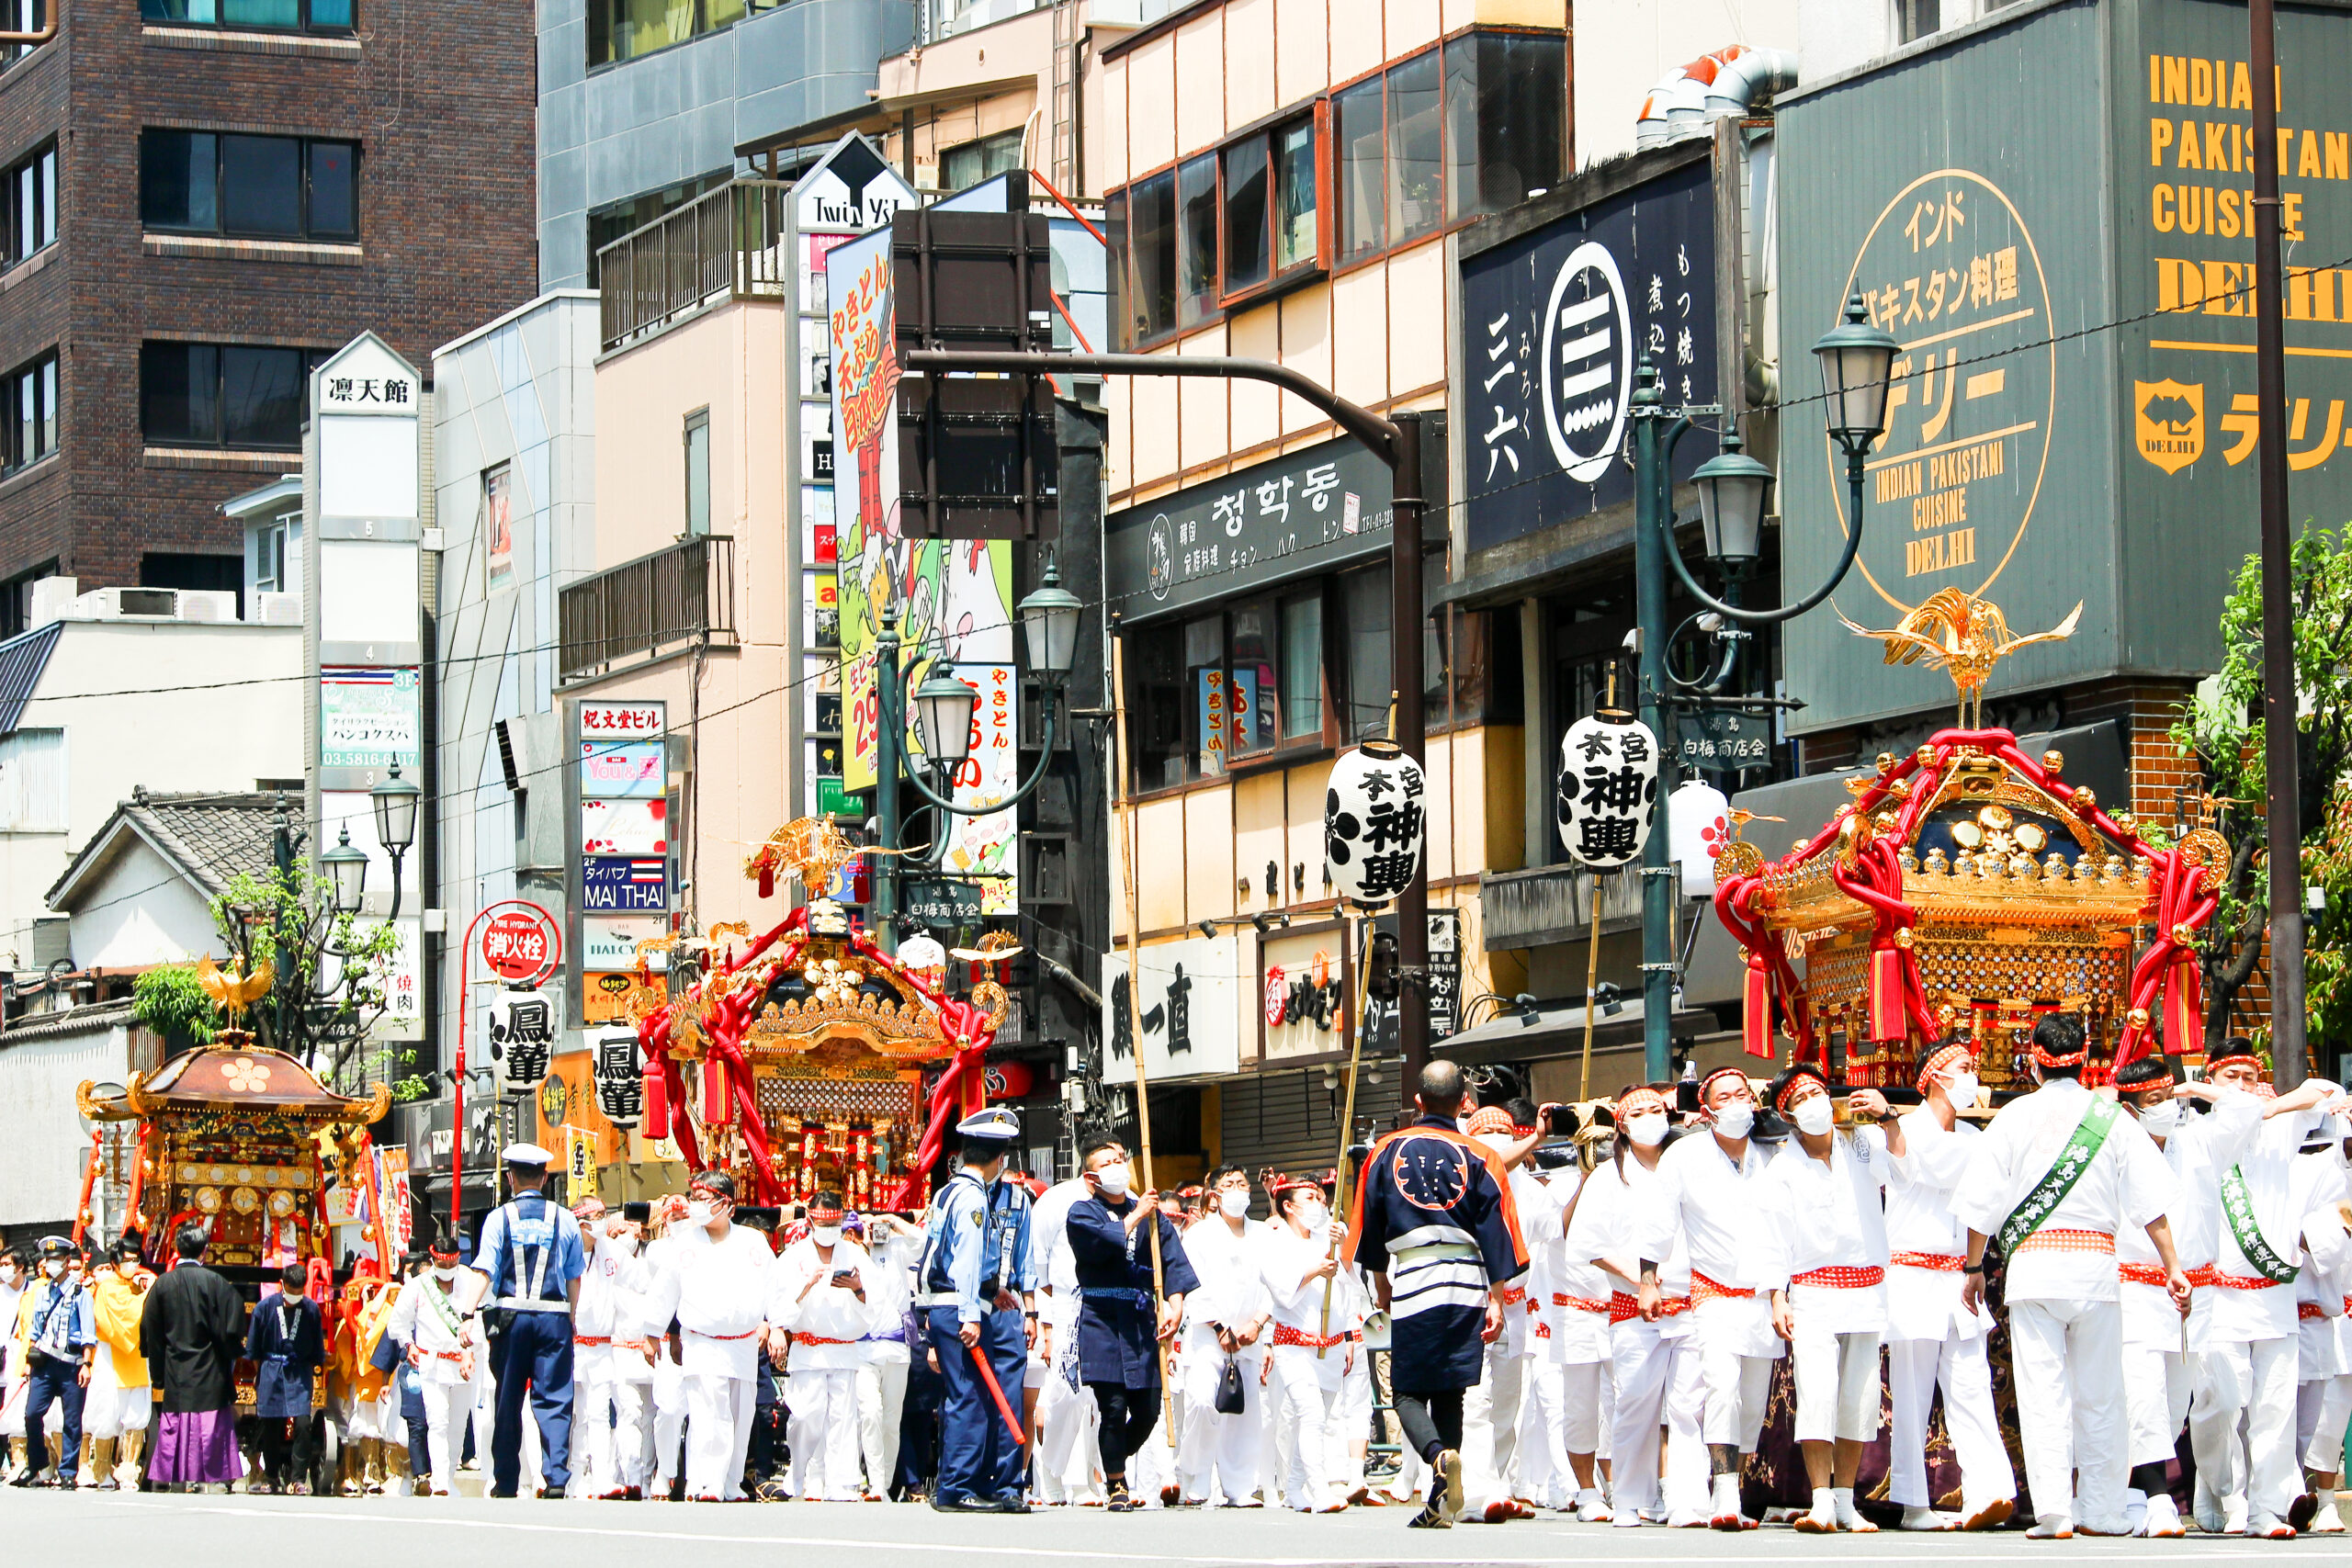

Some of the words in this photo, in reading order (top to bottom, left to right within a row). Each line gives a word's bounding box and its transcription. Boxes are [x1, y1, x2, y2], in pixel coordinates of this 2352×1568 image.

[2150, 54, 2281, 112] INDIA
[813, 197, 862, 223] Twin
[869, 197, 890, 223] Y's
[1905, 190, 1965, 254] インド
[2153, 183, 2304, 242] CUISIE
[832, 253, 888, 350] やきとん
[1861, 245, 2018, 333] パキスタン料理
[1647, 275, 1667, 392] 煮込み
[1677, 243, 1694, 407] もつ焼き
[1483, 311, 1520, 484] 三六
[1519, 332, 1532, 440] みろく
[1872, 346, 2006, 454] デリー
[843, 361, 888, 454] 日本酒
[2145, 439, 2195, 455] DELHI
[2220, 393, 2352, 471] デリ
[1876, 461, 1922, 504] INDIAN
[1930, 441, 2004, 491] PAKISTANI
[1211, 462, 1340, 537] 청학동
[1913, 488, 1967, 532] CUISINE
[365, 520, 373, 537] 5
[1183, 544, 1219, 576] 家庭料理
[1905, 526, 1976, 578] DELHI
[366, 645, 375, 660] 4
[394, 673, 414, 687] 3F
[583, 709, 661, 729] 紀文堂ビル
[991, 668, 1009, 749] やきとん
[333, 728, 410, 741] バンコクスパ
[1684, 738, 1767, 759] 白梅商店会
[367, 771, 374, 786] 3
[585, 755, 621, 780] You
[624, 764, 636, 780] &
[583, 857, 597, 867] 2F
[584, 885, 616, 908] MAI
[621, 885, 663, 908] THAI
[910, 902, 979, 918] 白梅商店会
[494, 919, 508, 929] FIRE
[509, 919, 538, 930] HYDRANT
[652, 916, 666, 925] 2F
[488, 931, 544, 962] 消火栓
[591, 943, 660, 955] HALCYN
[397, 974, 413, 1011] 焼肉
[1429, 976, 1452, 1037] 청학동
